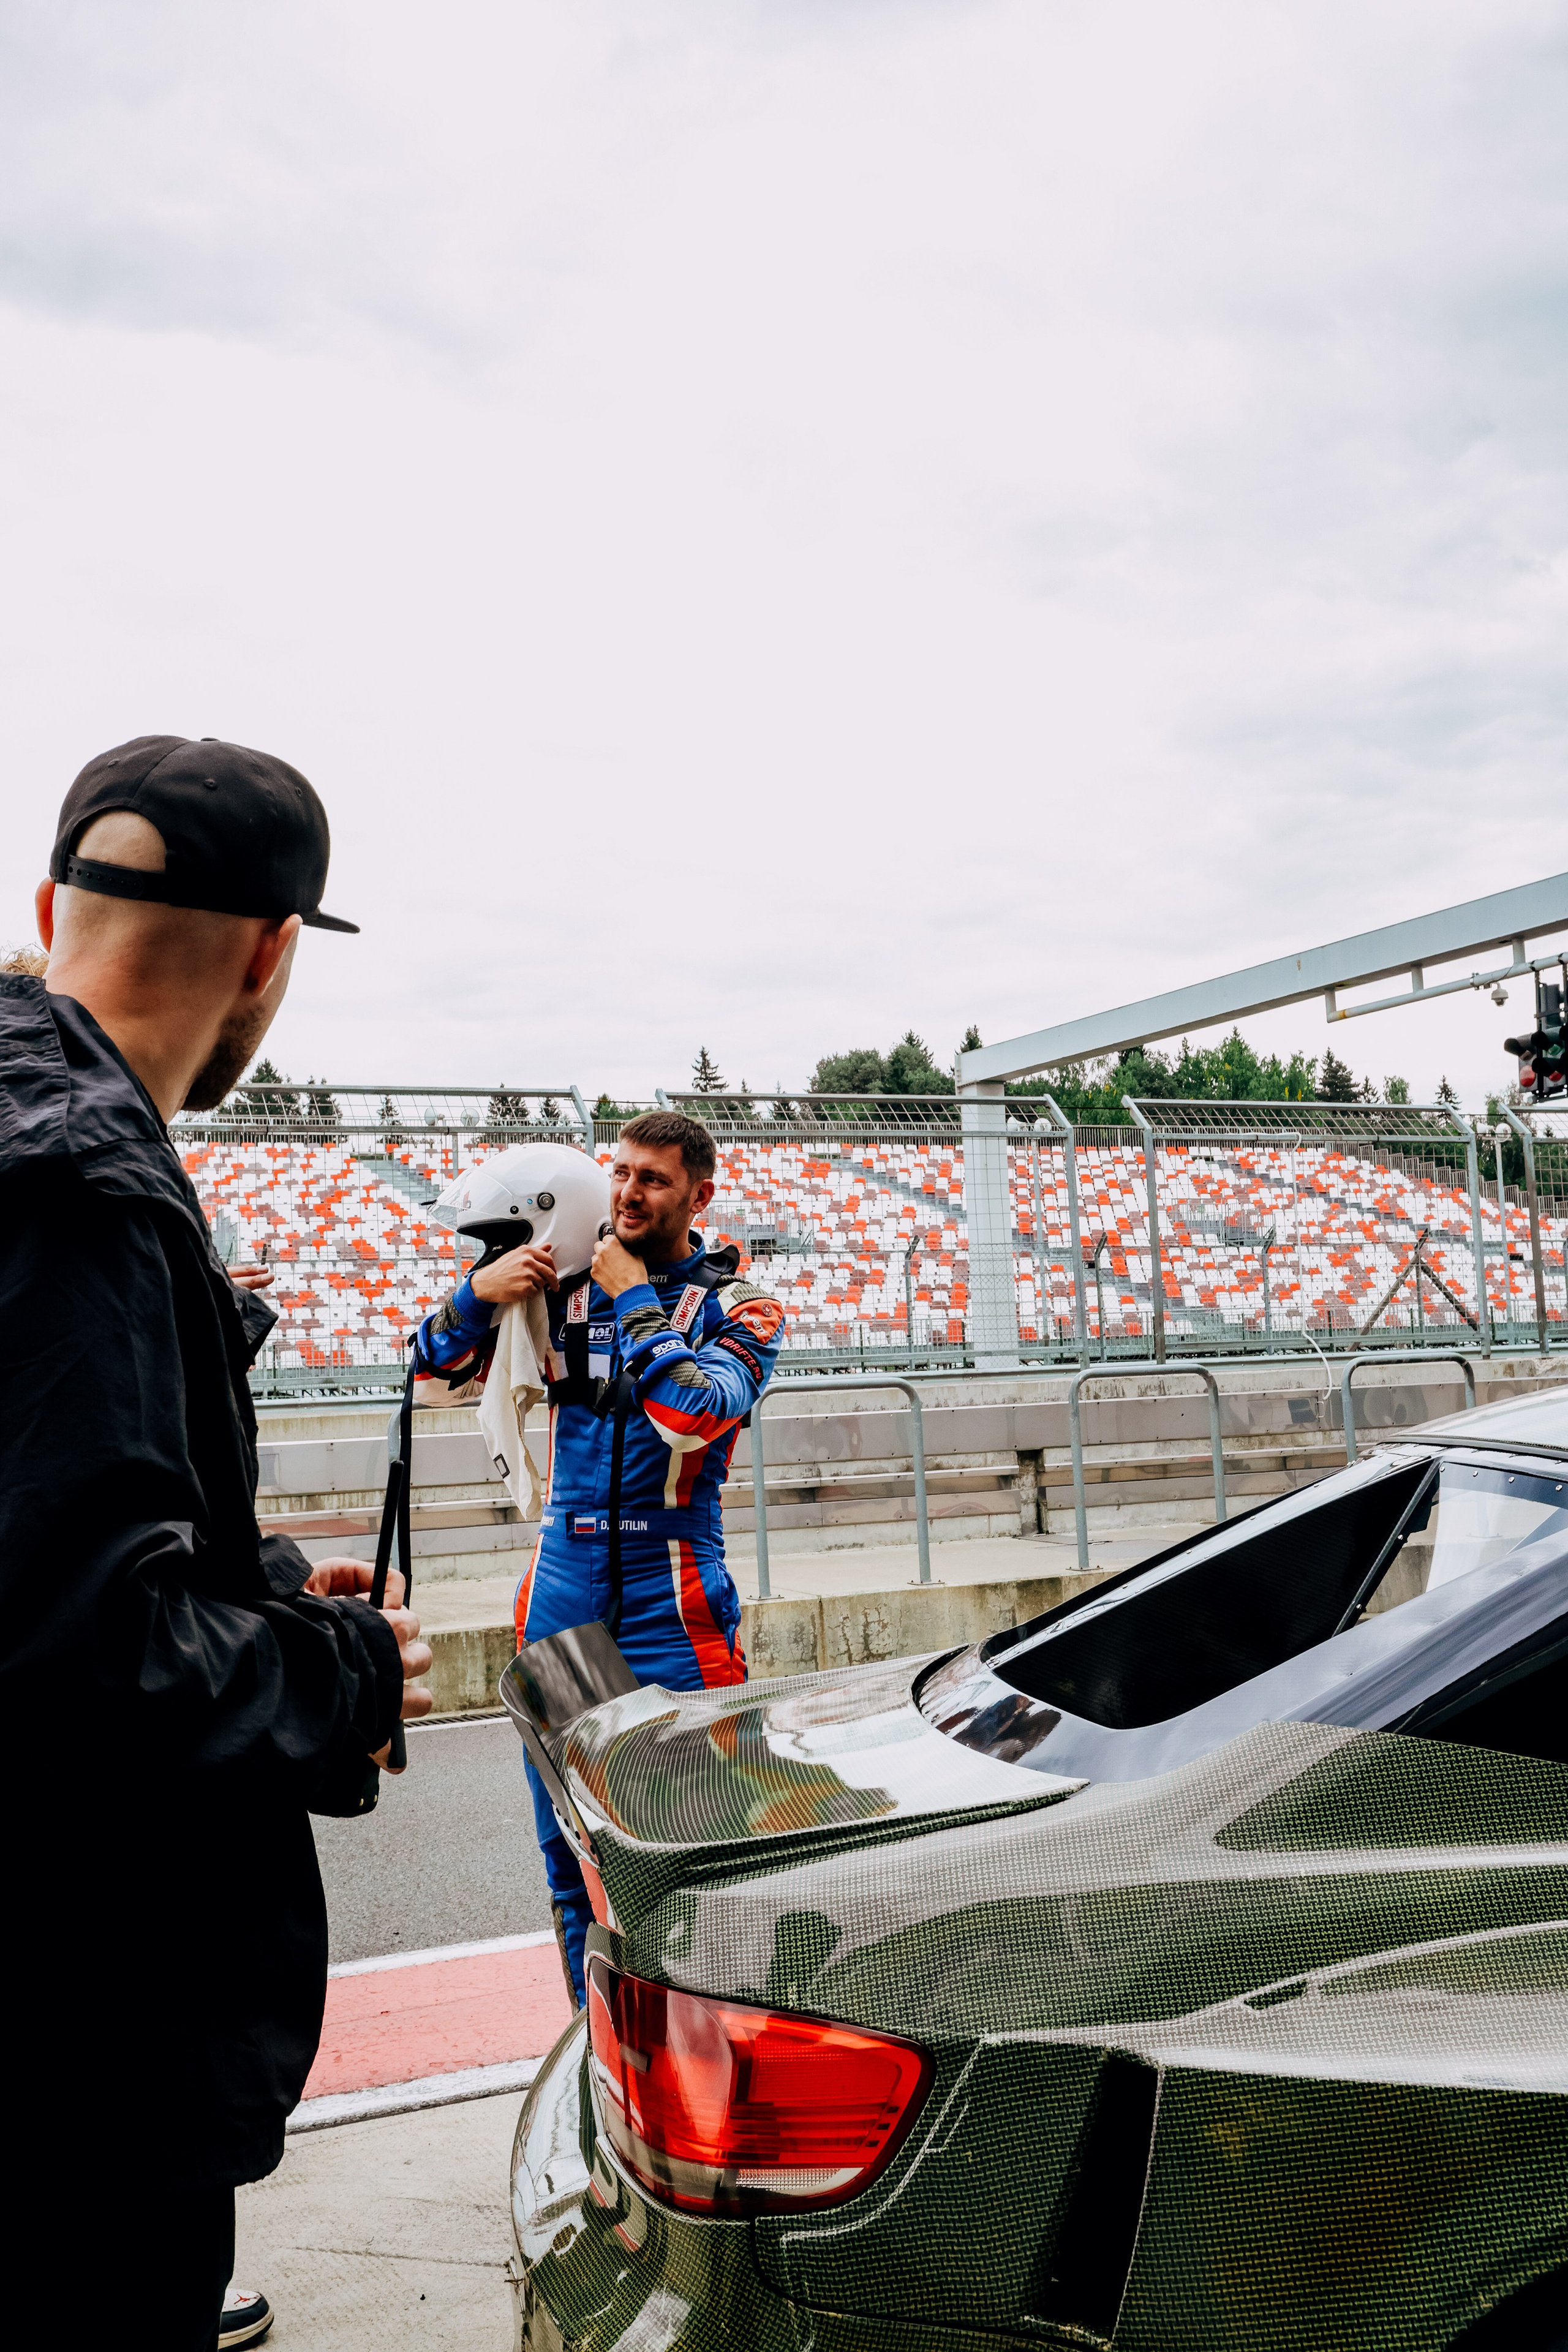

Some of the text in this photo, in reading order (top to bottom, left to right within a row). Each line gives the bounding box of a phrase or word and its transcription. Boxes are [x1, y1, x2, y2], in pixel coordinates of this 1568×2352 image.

[676, 1290, 699, 1327] SIMPSON
[719, 1336, 762, 1379] VDRIFTE.RU
[619, 1520, 647, 1531] UTILIN
